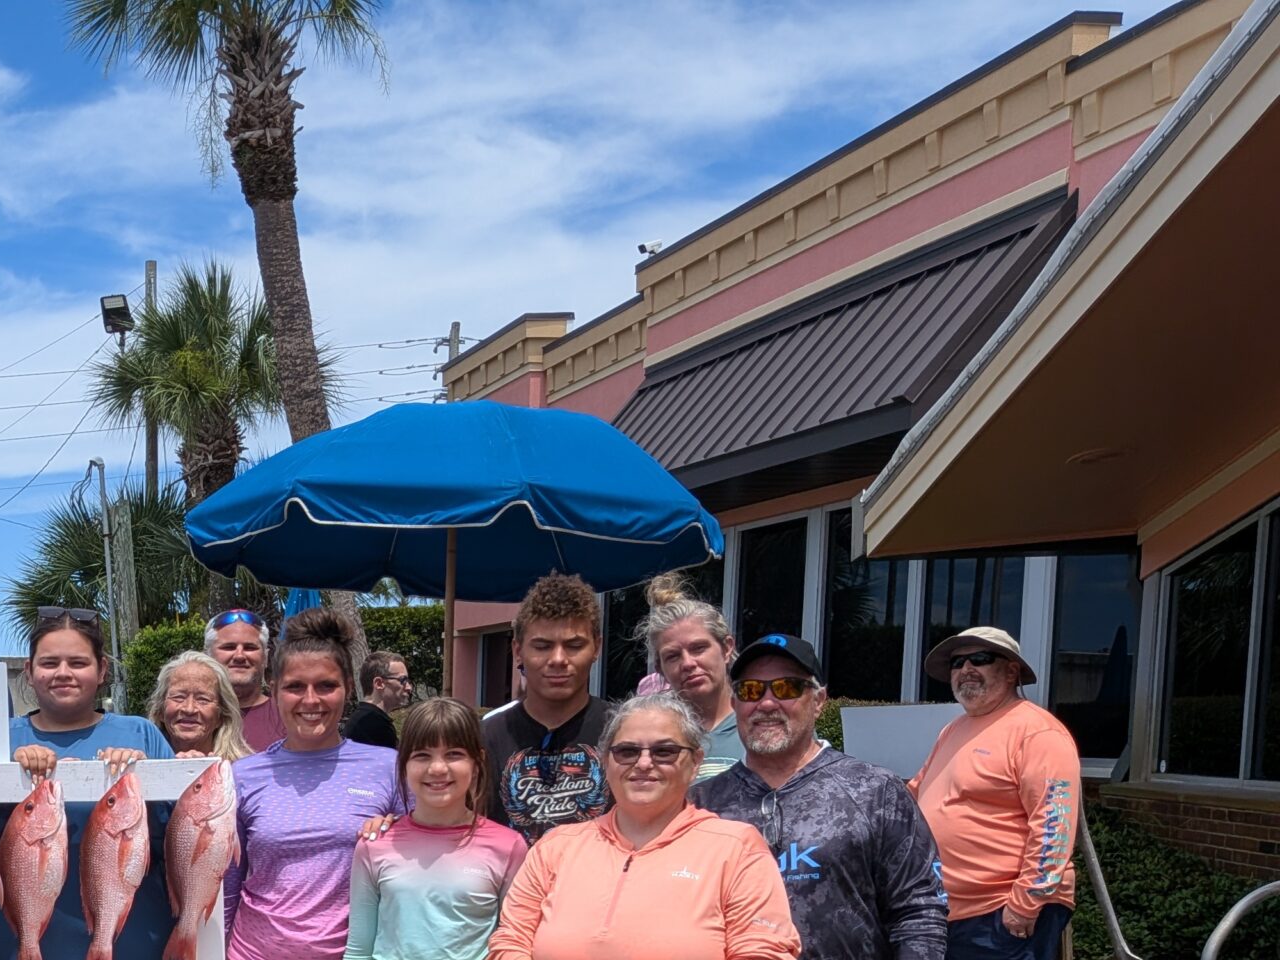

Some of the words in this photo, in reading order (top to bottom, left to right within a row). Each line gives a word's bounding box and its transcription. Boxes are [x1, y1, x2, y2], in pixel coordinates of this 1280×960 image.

[563, 752, 586, 762] POWER
[517, 776, 594, 800] Freedom
[527, 795, 577, 818] Ride
